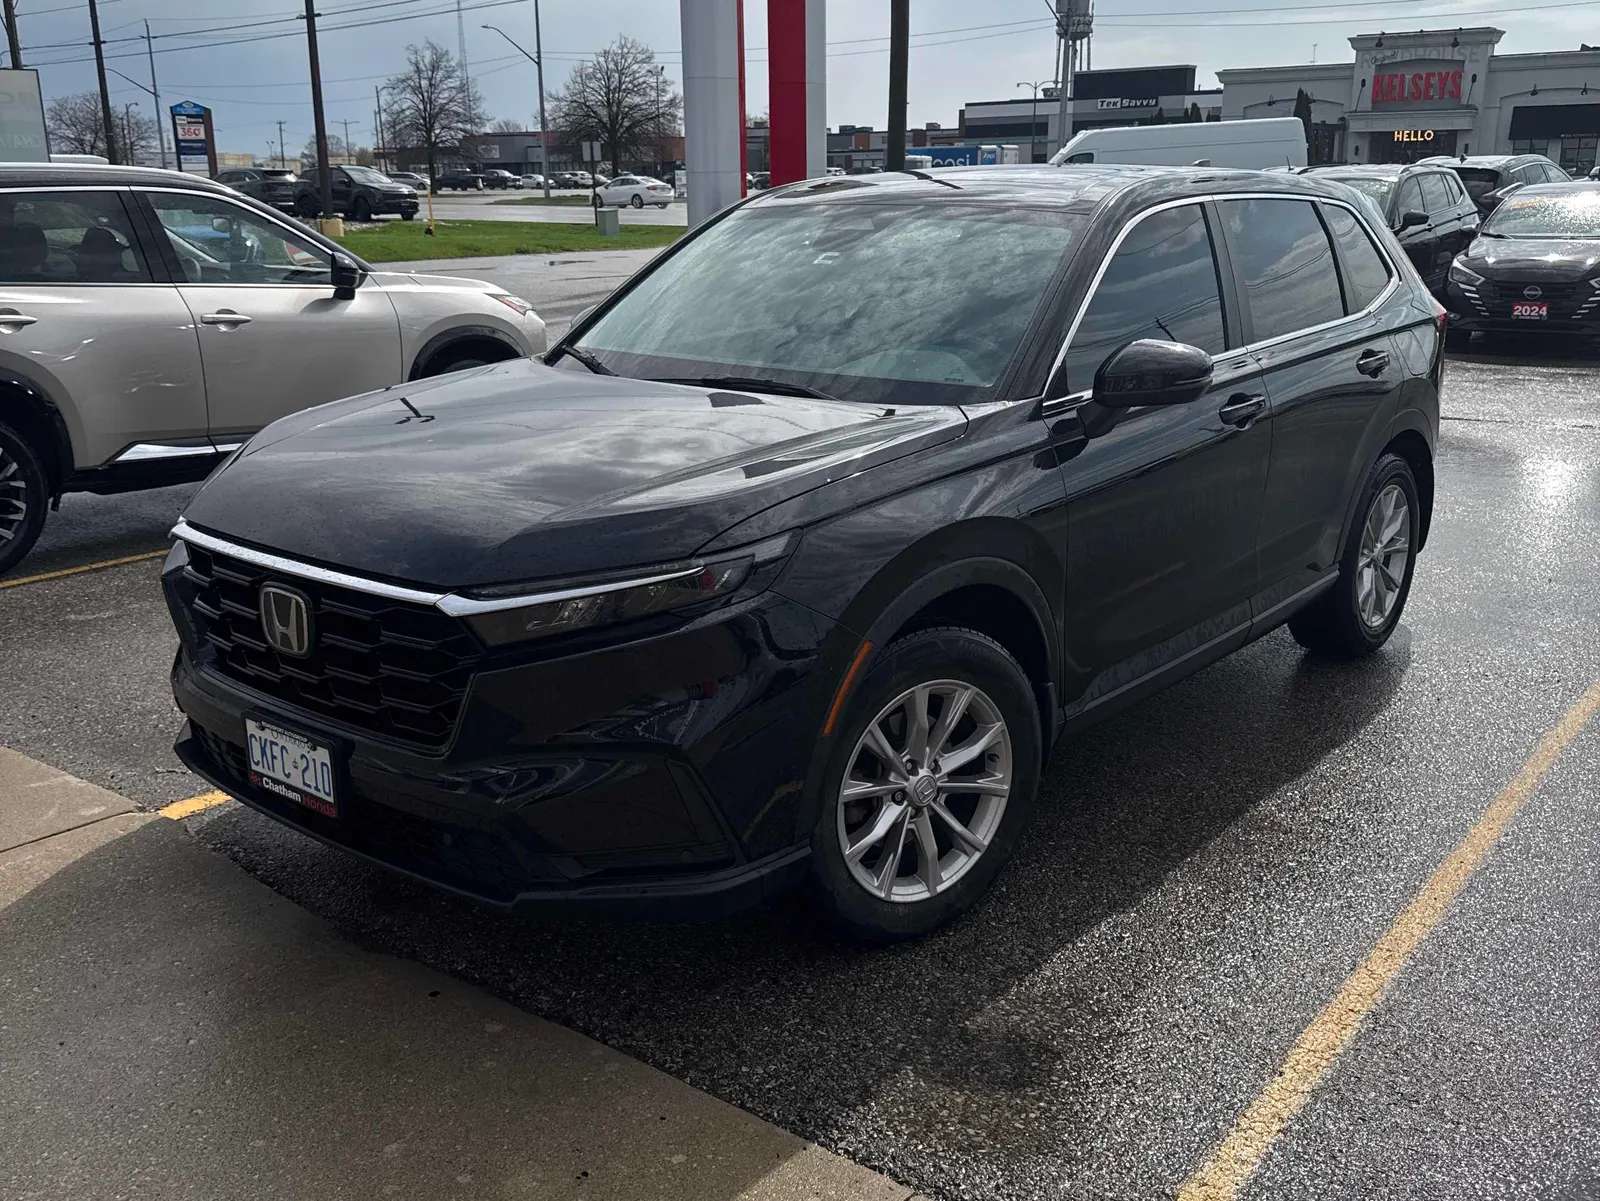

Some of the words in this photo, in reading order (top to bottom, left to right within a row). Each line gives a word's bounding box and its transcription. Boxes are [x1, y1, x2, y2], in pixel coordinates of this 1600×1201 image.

[1371, 70, 1463, 103] KELSEYS
[1394, 130, 1434, 142] HELLO
[1513, 305, 1548, 316] 2024
[249, 733, 292, 779] CKFC
[300, 753, 332, 797] 210
[262, 777, 302, 802] Chatham
[302, 793, 337, 818] Honda
